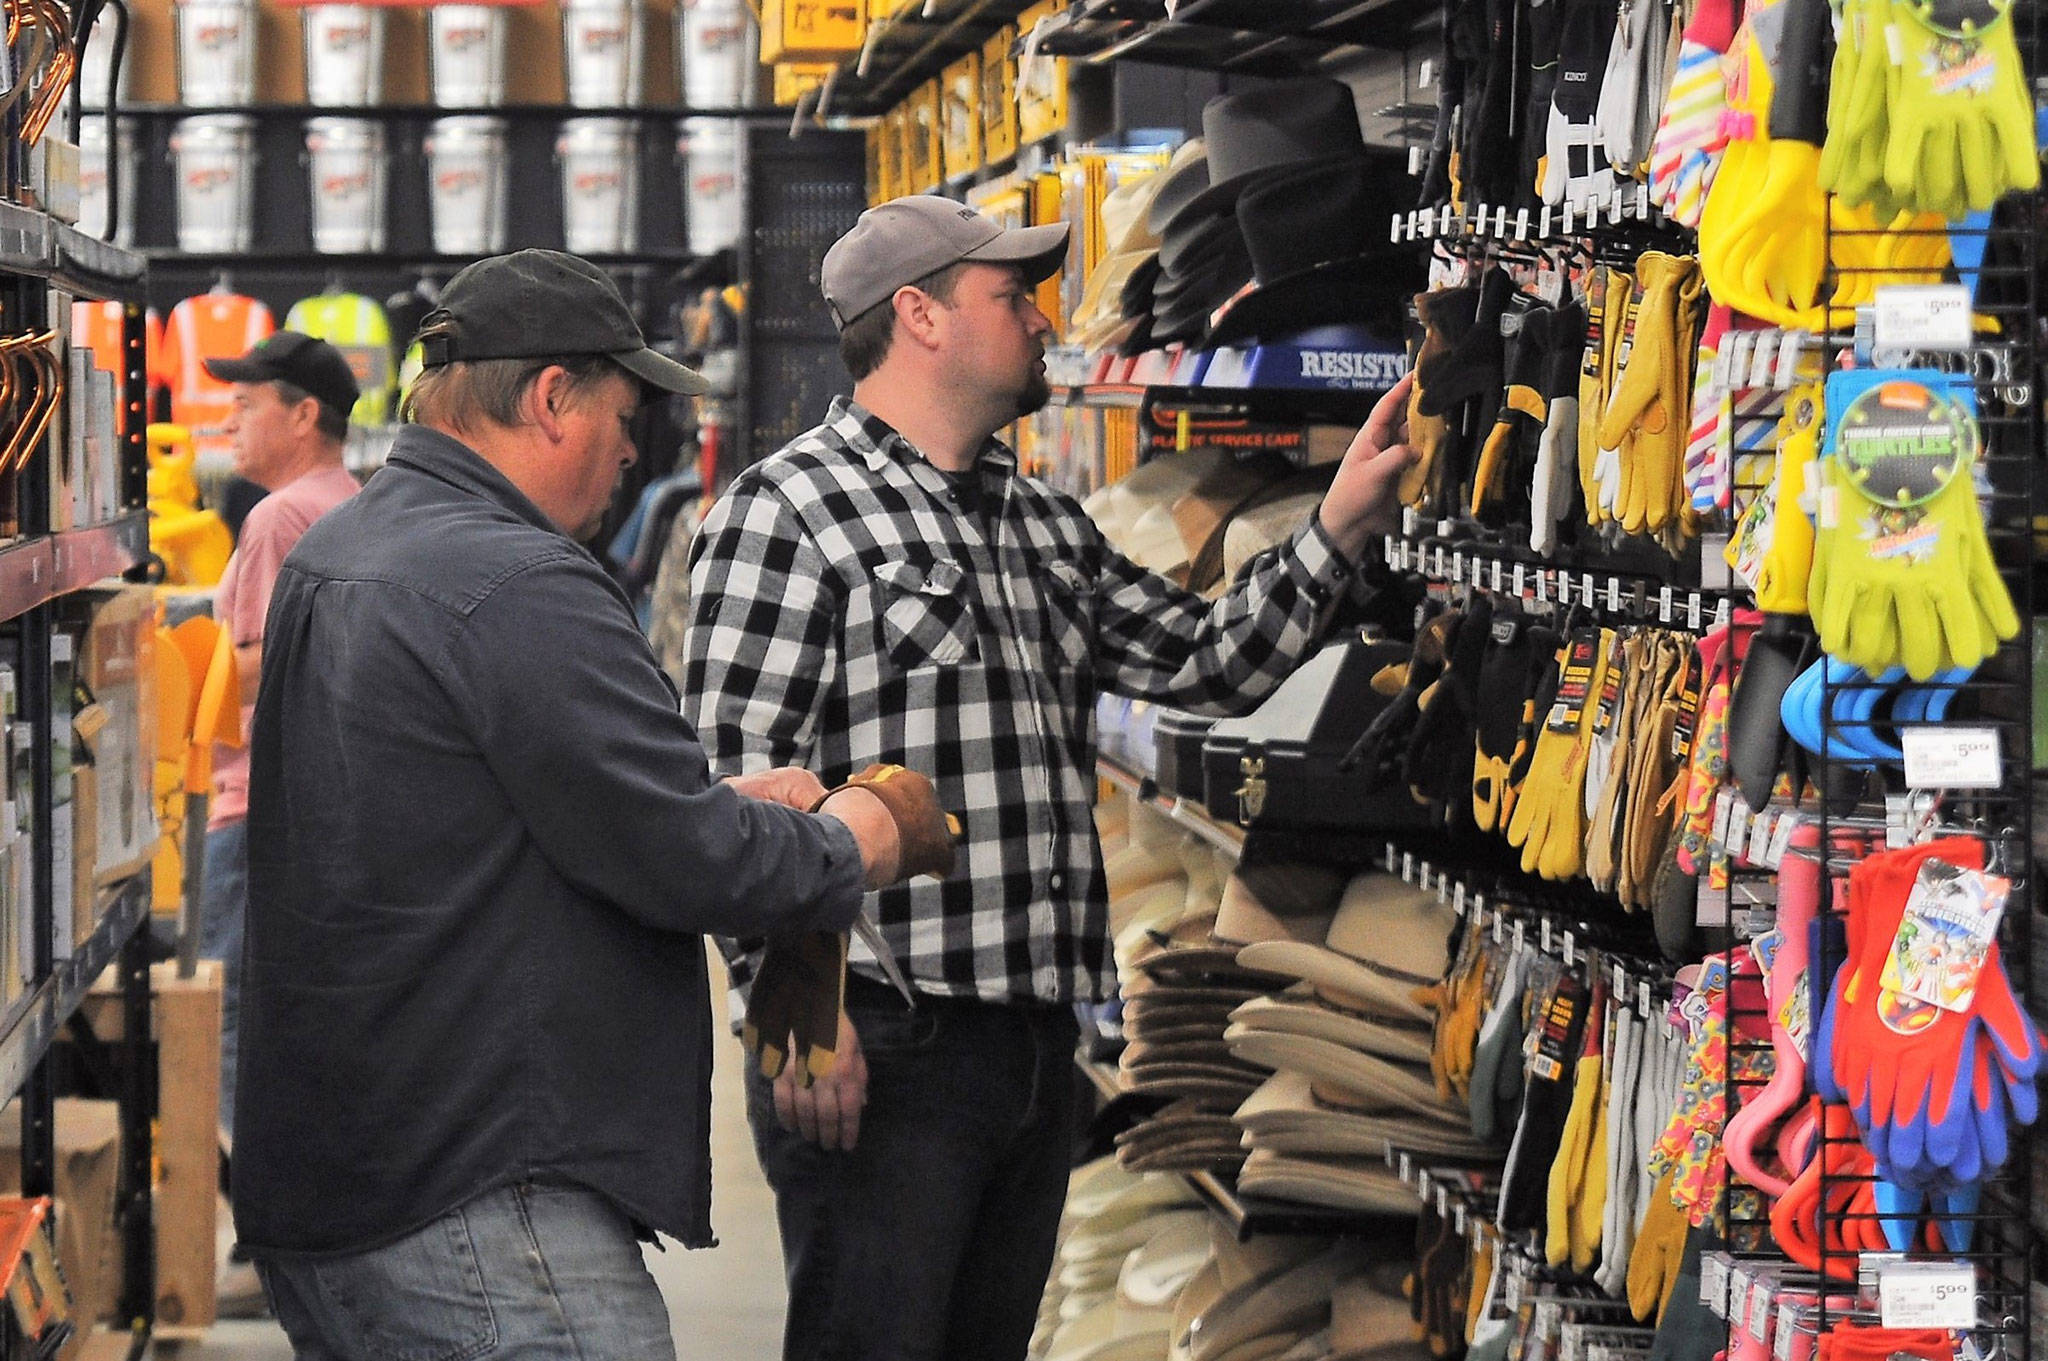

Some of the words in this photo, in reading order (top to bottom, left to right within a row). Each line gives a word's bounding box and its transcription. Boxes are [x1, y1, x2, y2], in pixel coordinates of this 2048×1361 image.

[1300, 350, 1409, 379] RESISTO
[1151, 434, 1205, 448] PLAIC
[1208, 433, 1263, 447] SERVICE
[1265, 432, 1300, 447] CART
